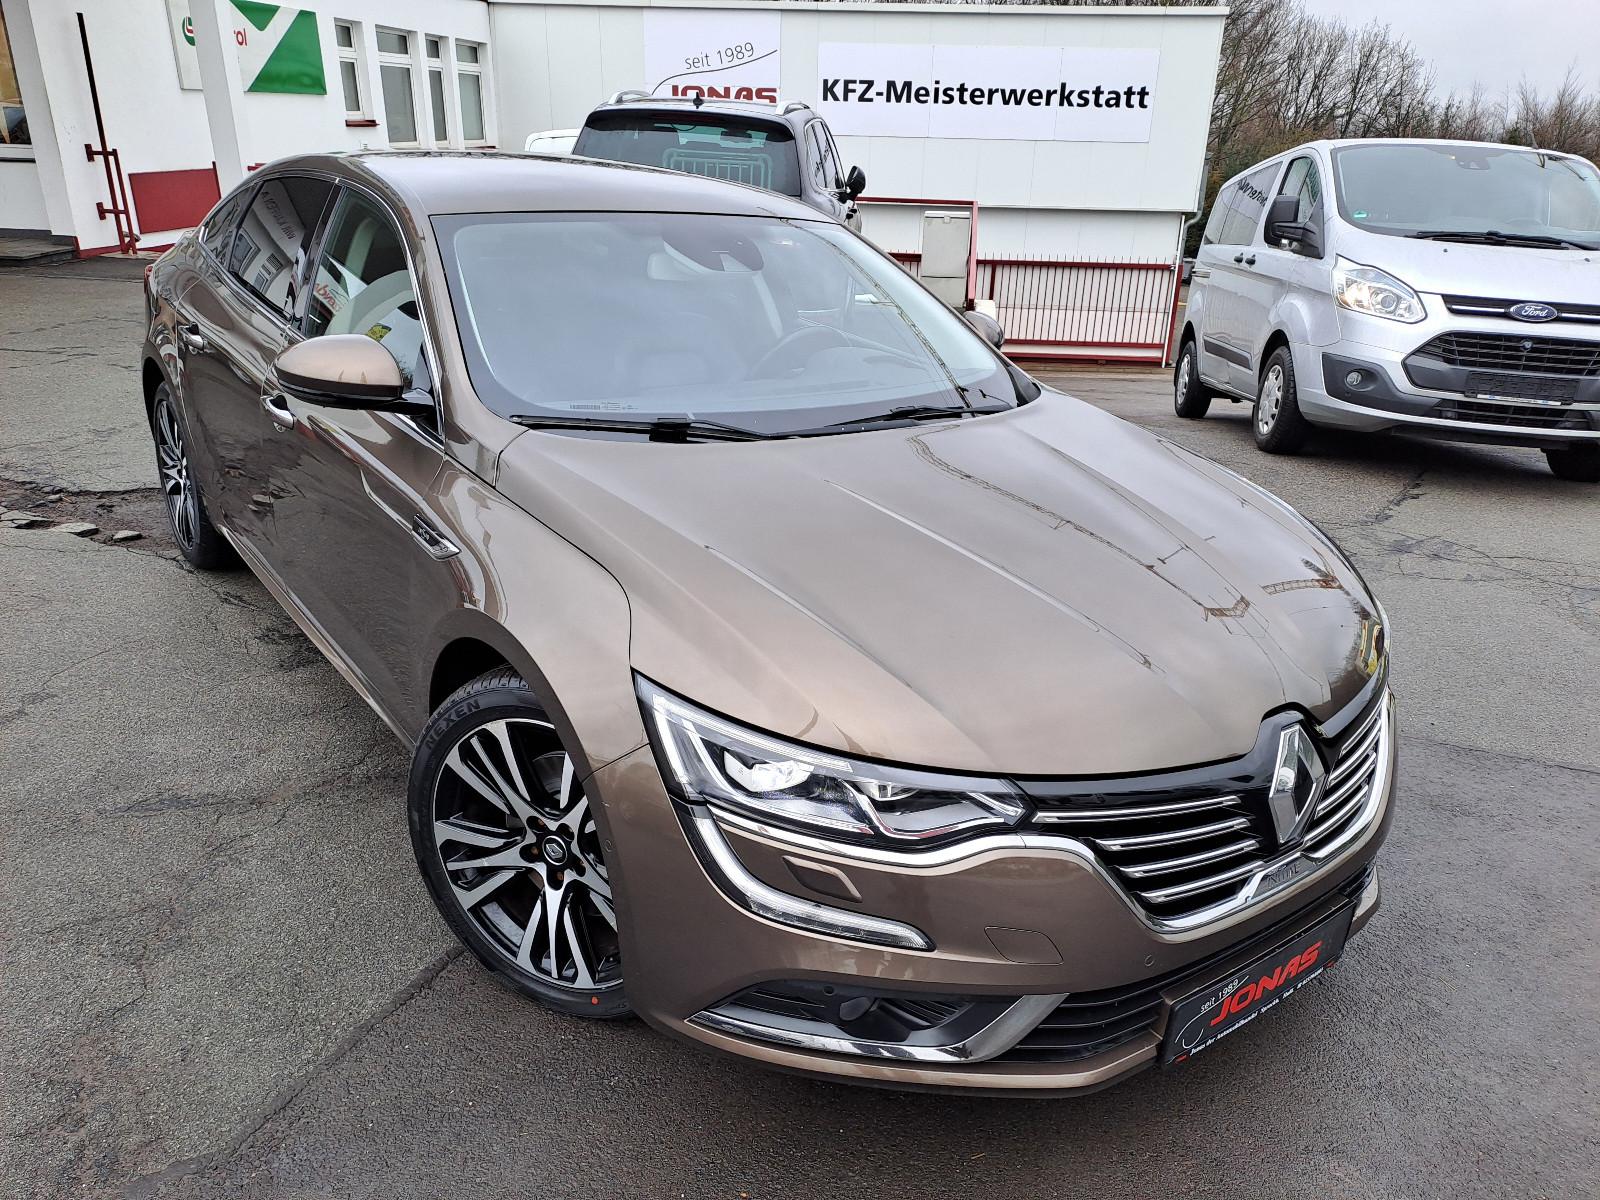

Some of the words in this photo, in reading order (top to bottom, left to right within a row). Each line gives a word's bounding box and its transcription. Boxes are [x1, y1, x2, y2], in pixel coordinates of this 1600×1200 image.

[685, 51, 711, 70] seit
[717, 42, 754, 64] 1989
[822, 78, 1150, 109] KFZ-Meisterwerkstatt
[1521, 305, 1548, 317] Ford
[424, 698, 481, 750] NEXEN
[1200, 996, 1216, 1013] seit
[1218, 978, 1239, 1000] 1989
[1210, 940, 1324, 1026] JONAS
